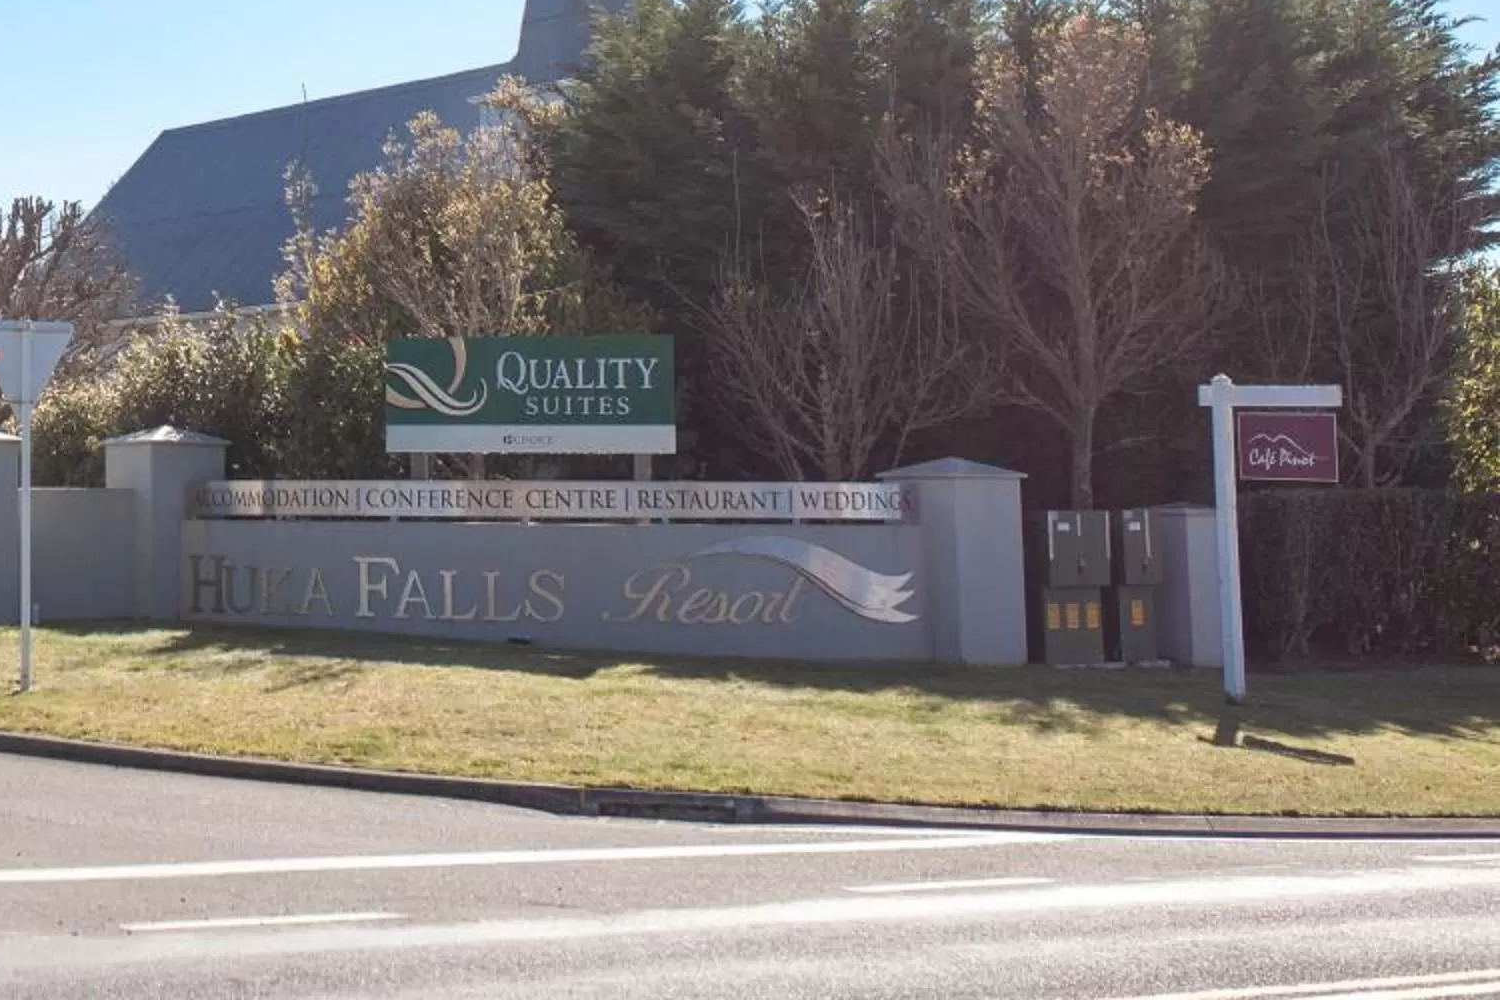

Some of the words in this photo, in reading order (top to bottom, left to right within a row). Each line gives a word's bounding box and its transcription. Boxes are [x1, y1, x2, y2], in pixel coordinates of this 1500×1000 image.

[496, 351, 658, 394] QUALITY
[525, 396, 631, 416] SUITES
[365, 487, 514, 510] CONFERENCE
[525, 488, 617, 509] CENTRE
[637, 489, 782, 511] RESTAURANT
[188, 554, 334, 616] HUKA
[352, 556, 566, 622] FALLS
[602, 564, 806, 624] Resort
